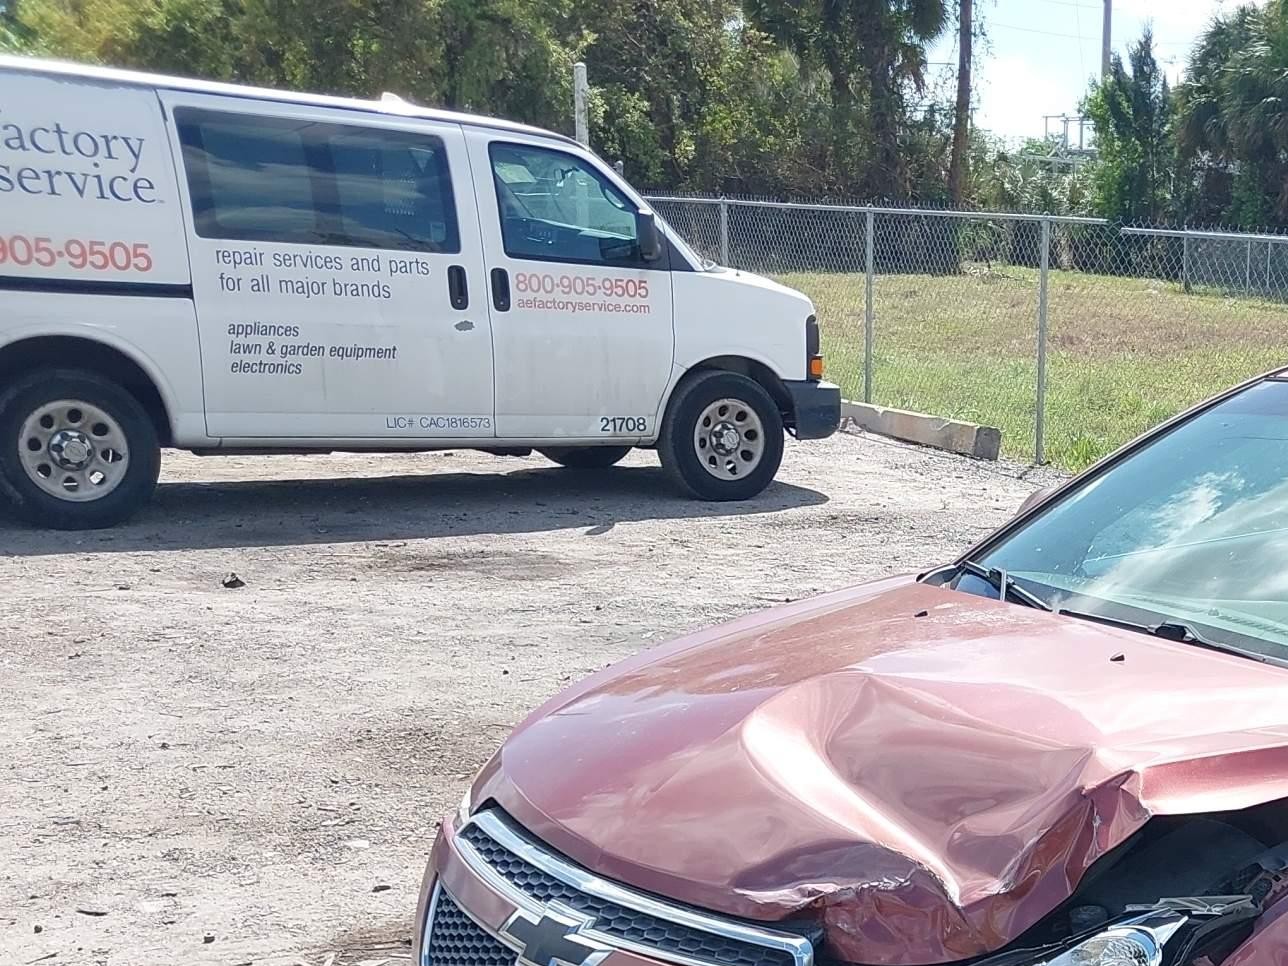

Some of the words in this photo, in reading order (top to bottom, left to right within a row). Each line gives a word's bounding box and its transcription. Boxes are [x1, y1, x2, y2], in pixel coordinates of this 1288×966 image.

[0, 119, 145, 174] actory
[215, 248, 265, 269] repair
[272, 250, 343, 271] services
[350, 254, 381, 273] and
[389, 257, 430, 277] parts
[219, 272, 243, 292] for
[250, 274, 271, 293] all
[279, 276, 327, 299] major
[332, 278, 391, 299] brands
[516, 297, 650, 314] aefactoryservice.com
[227, 321, 300, 339] appliances
[229, 340, 262, 355] lawn
[266, 341, 276, 356] &
[280, 342, 325, 359] garden
[329, 344, 397, 361] equipment
[230, 359, 303, 375] electronics
[386, 416, 415, 429] LIC#
[419, 416, 491, 430] CAC1816573
[600, 416, 647, 432] 21708
